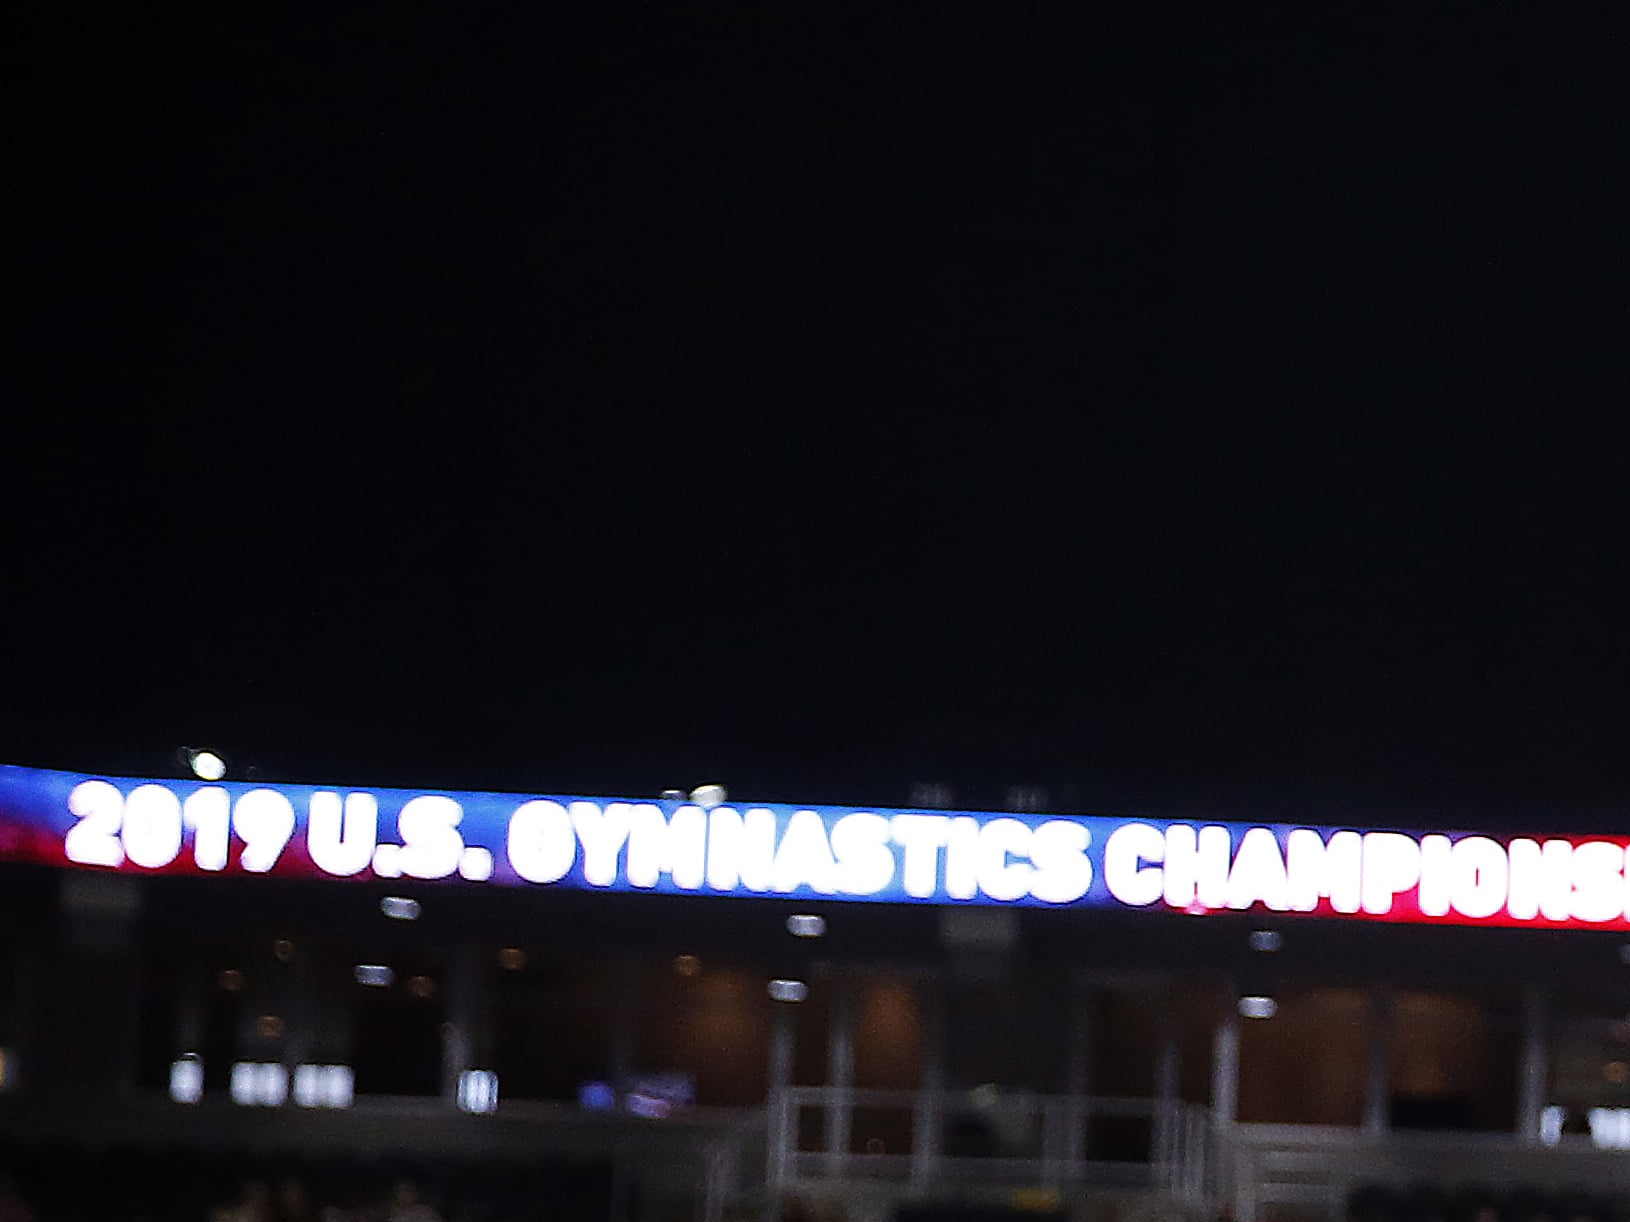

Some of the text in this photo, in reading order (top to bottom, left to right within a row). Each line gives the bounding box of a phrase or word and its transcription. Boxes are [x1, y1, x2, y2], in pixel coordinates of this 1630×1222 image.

[65, 780, 296, 873] 2019
[307, 790, 493, 882] U.S.
[507, 799, 1094, 905] GYMNASTICS
